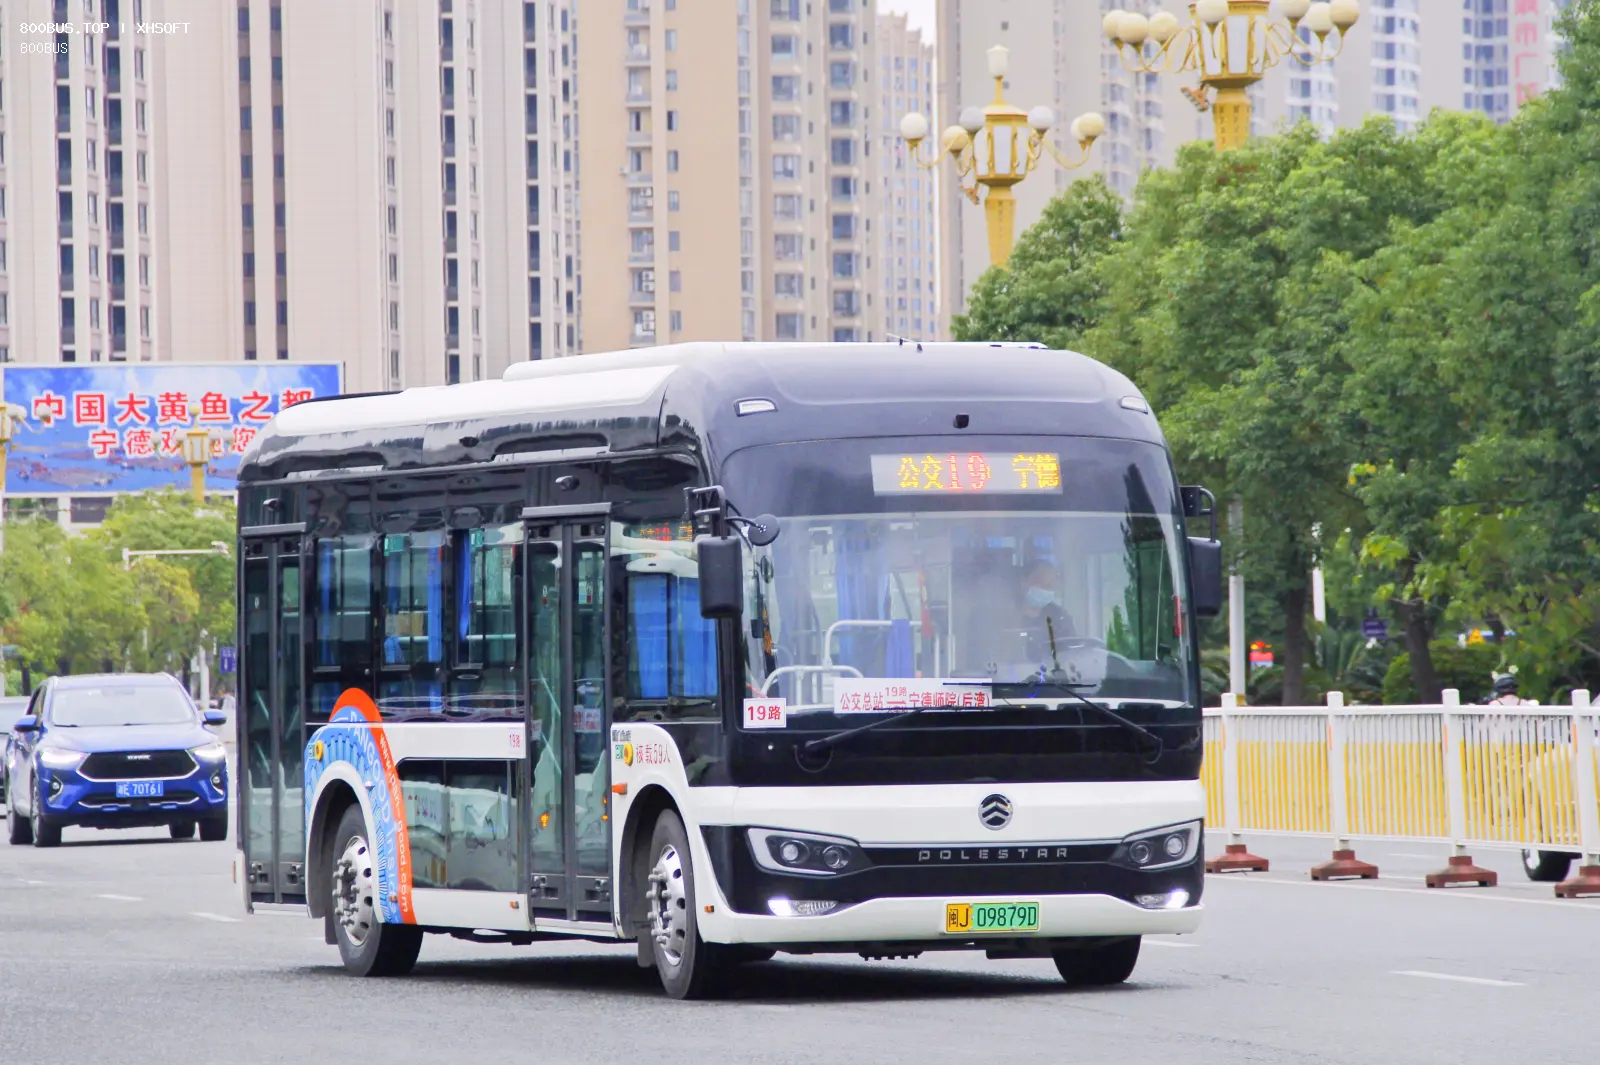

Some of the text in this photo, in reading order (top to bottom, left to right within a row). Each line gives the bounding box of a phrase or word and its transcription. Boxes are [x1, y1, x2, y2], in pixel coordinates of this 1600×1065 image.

[91, 428, 257, 455] 宁德欢您
[885, 687, 907, 697] 19路
[840, 693, 884, 711] 公交总站
[747, 705, 782, 722] 19路
[918, 847, 1069, 862] POLESTAR
[977, 906, 1037, 927] 09879D
